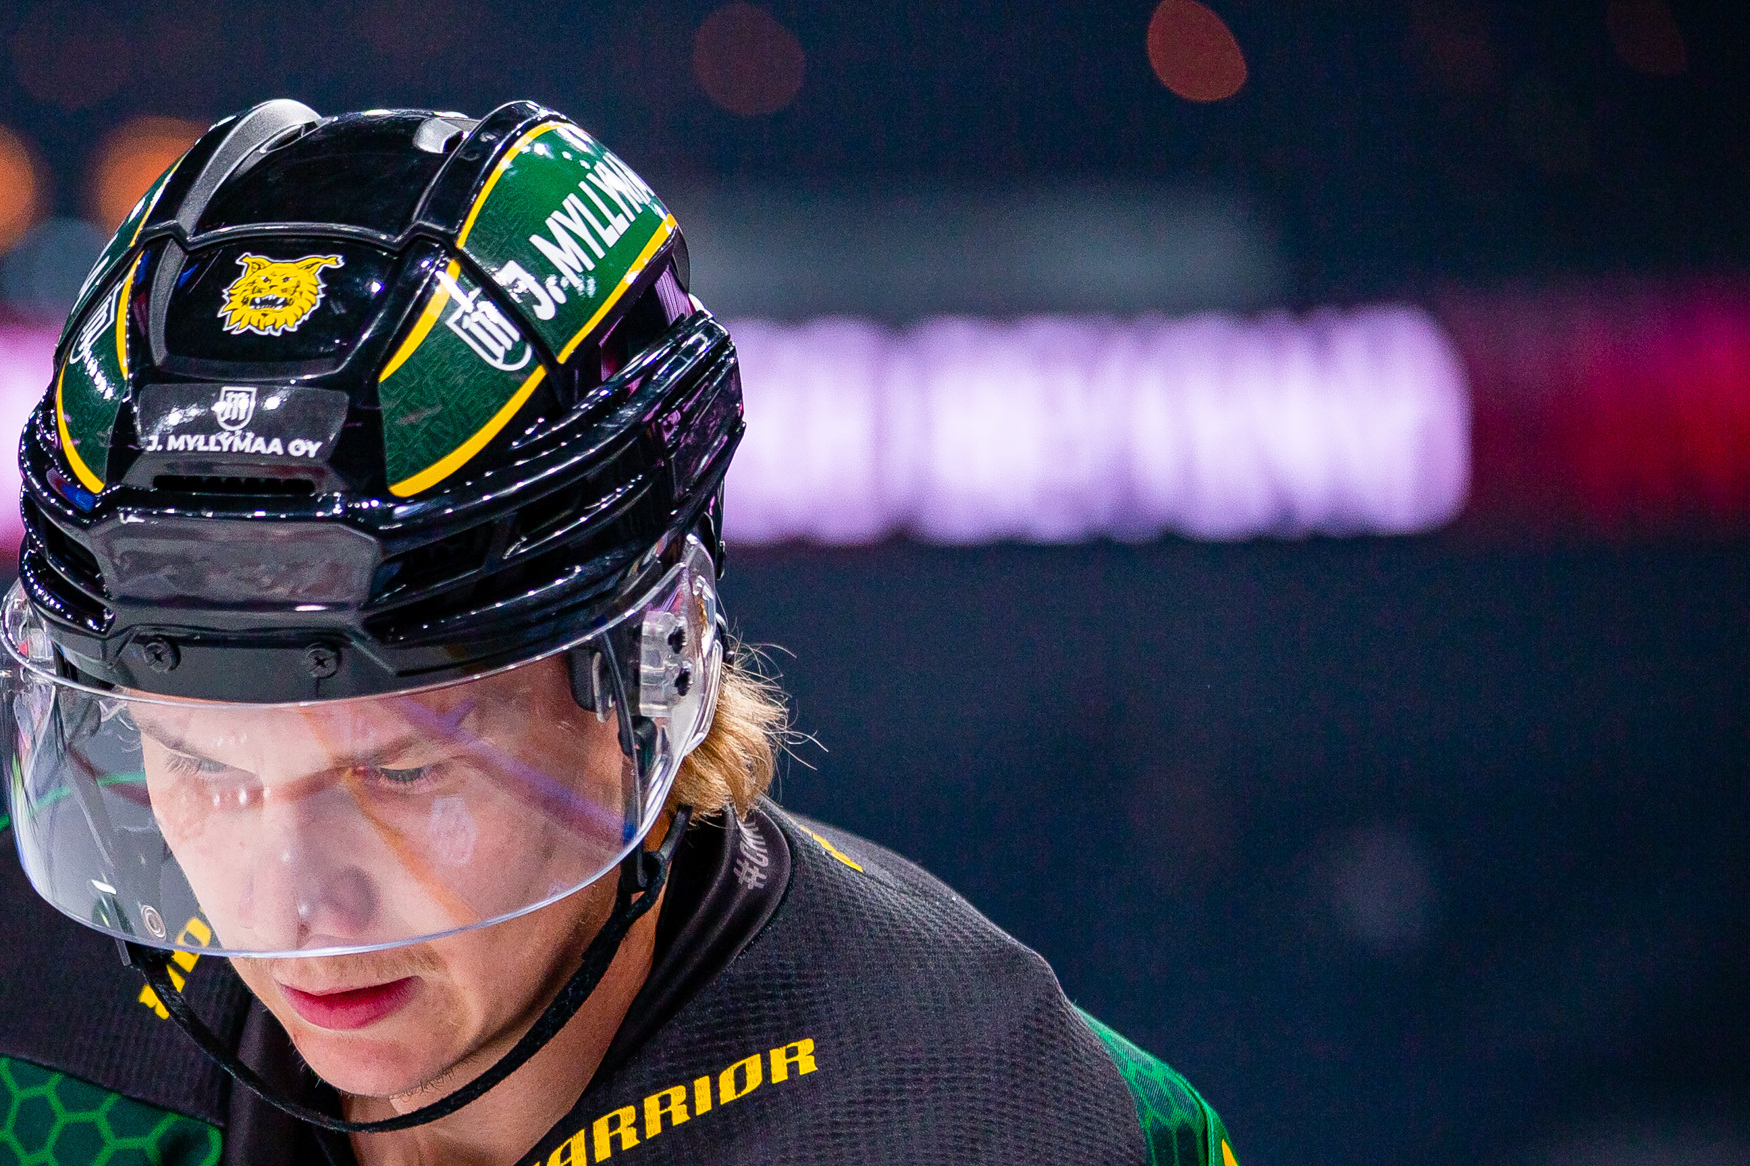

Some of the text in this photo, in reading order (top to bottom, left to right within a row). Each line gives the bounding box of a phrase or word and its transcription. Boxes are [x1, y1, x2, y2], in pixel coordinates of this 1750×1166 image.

[146, 433, 324, 458] J. MYLLYMAA OY
